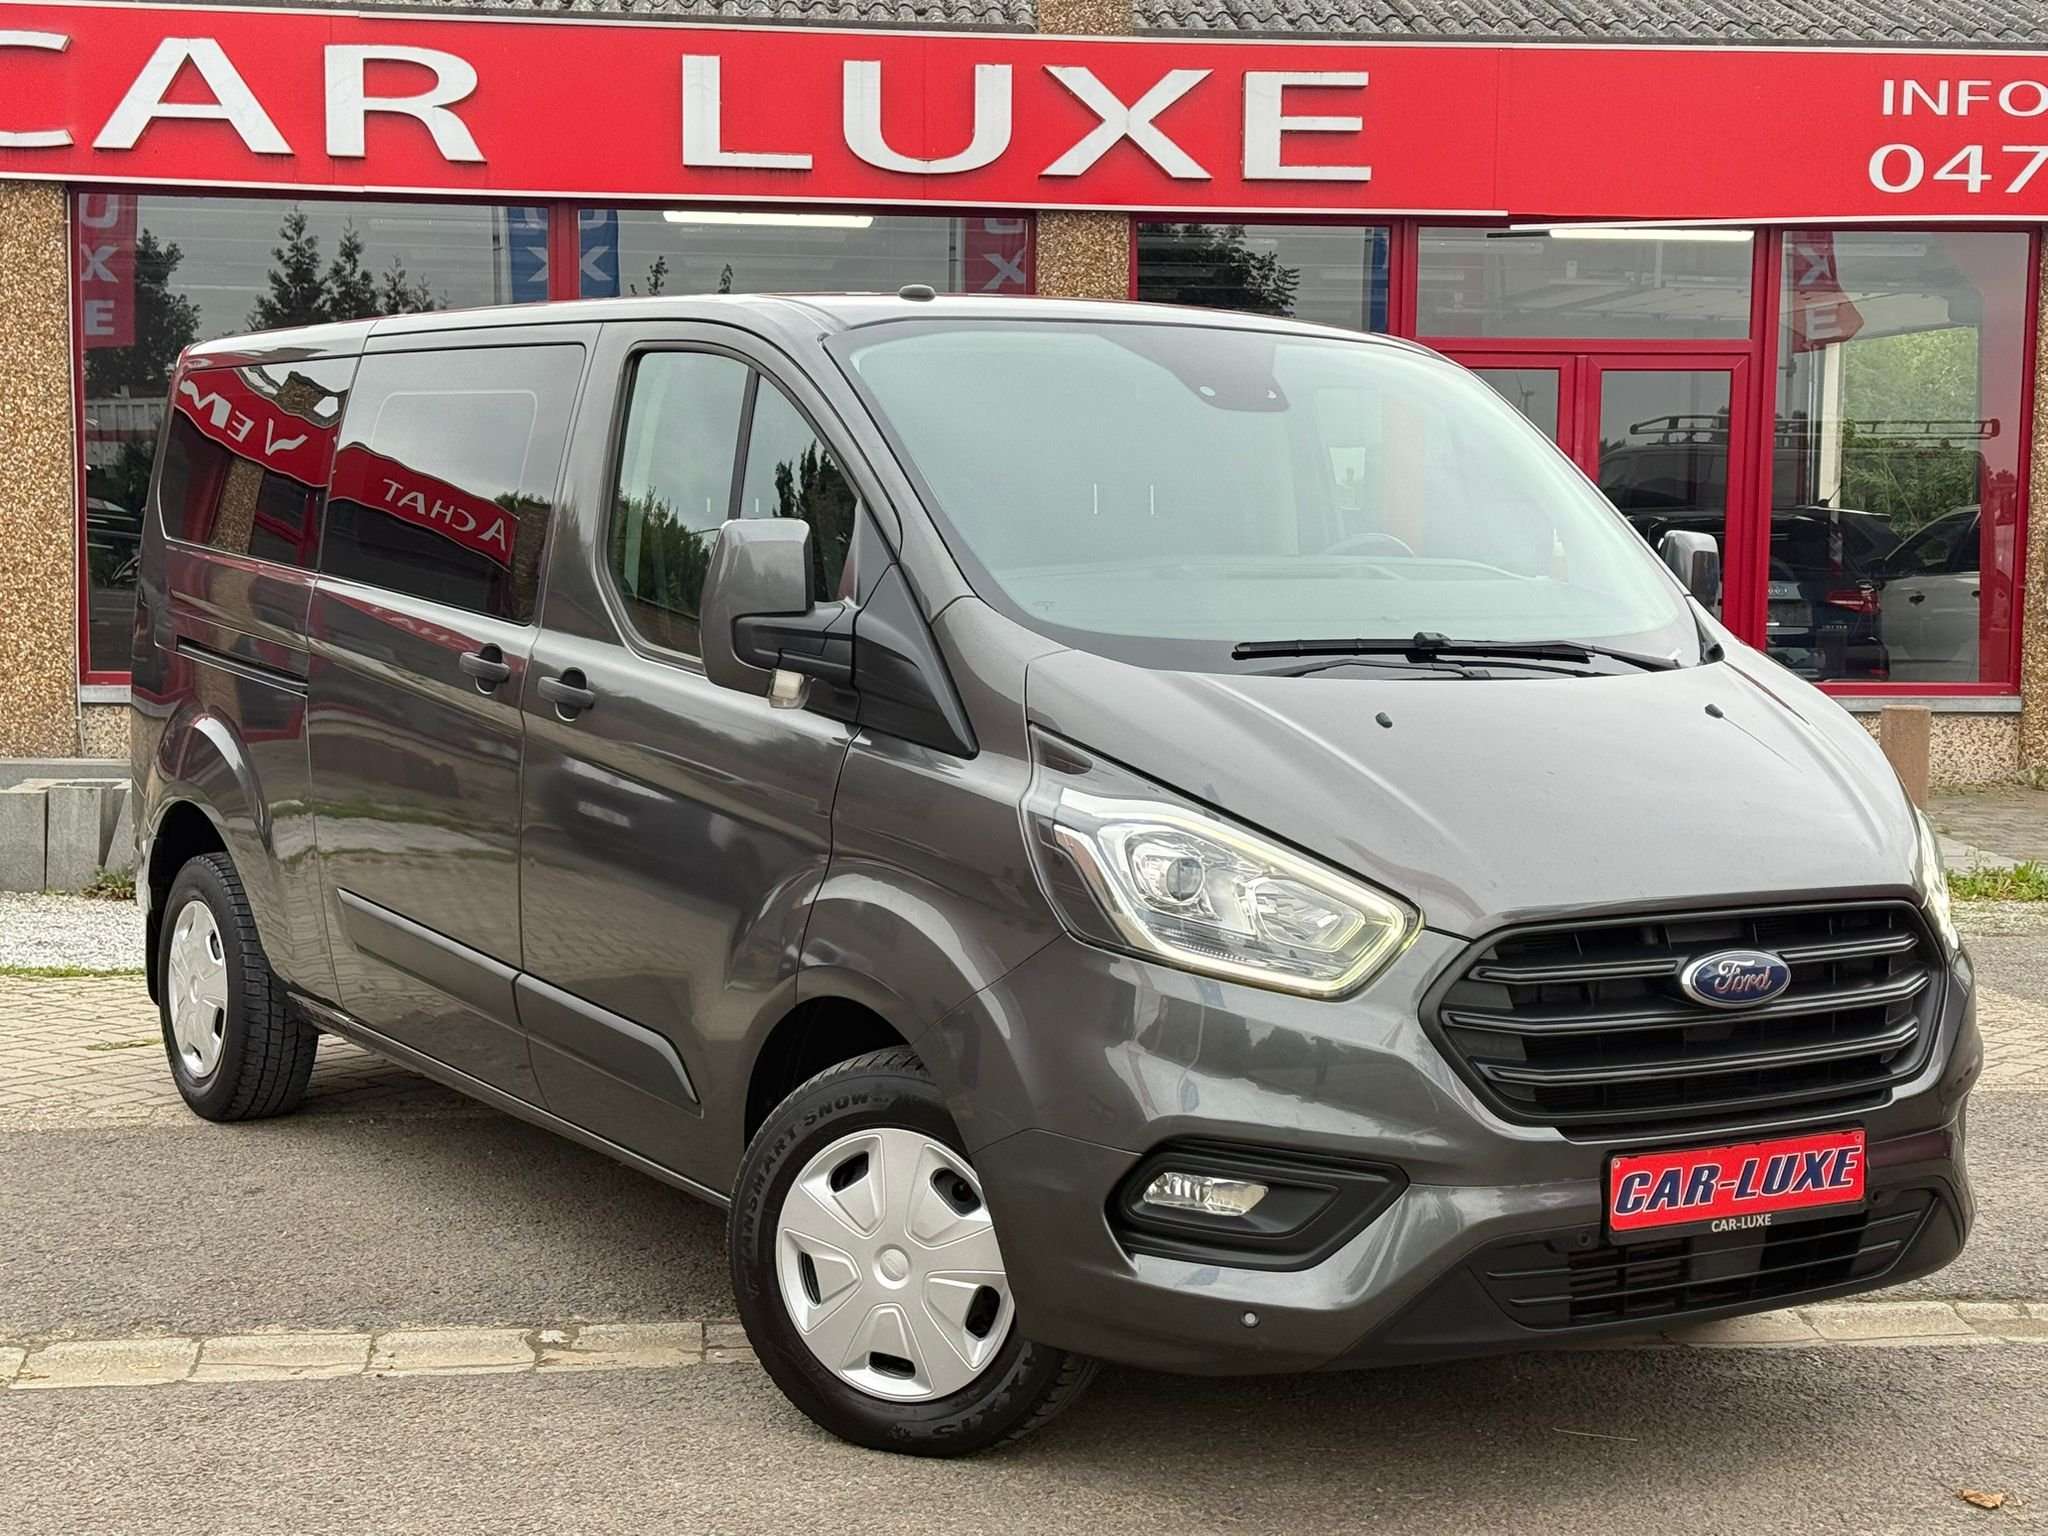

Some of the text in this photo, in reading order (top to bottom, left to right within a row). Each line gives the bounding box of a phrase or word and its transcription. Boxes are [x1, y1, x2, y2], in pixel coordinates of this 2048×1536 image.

[681, 54, 1372, 182] LUXE
[1882, 79, 2048, 118] INFO
[1868, 143, 2048, 194] 047
[1714, 960, 1772, 994] Ford
[803, 1094, 870, 1127] SNOW
[1614, 1145, 1862, 1217] CAR-LUXE
[1711, 1213, 1773, 1233] CAR-LUXE
